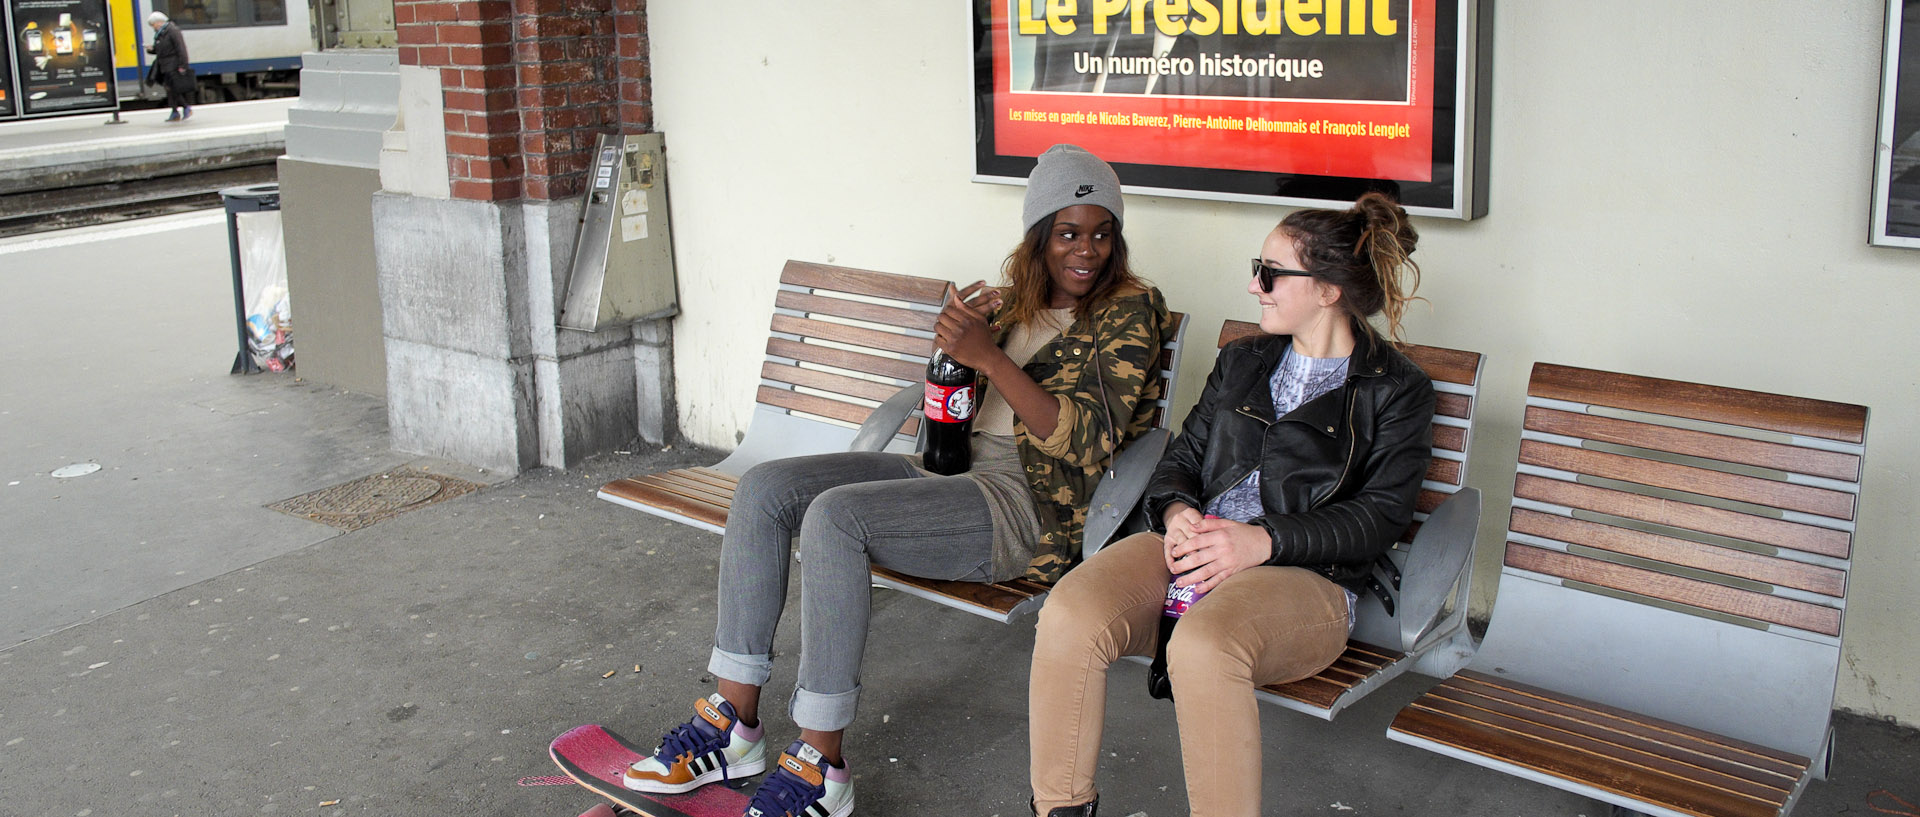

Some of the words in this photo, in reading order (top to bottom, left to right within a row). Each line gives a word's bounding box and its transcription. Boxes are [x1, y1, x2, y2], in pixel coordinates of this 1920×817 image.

[1018, 0, 1077, 35] Le
[1073, 52, 1102, 74] Un
[1108, 51, 1194, 76] numéro
[1200, 53, 1323, 81] historique
[1009, 108, 1022, 121] Les
[1024, 109, 1047, 122] mises
[1049, 113, 1059, 122] en
[1061, 111, 1085, 125] garde
[1087, 112, 1098, 124] de
[1099, 112, 1130, 126] Nicolas
[1132, 113, 1171, 130] Baverez,
[1173, 114, 1243, 130] Pierre-Antoine
[1246, 117, 1307, 134] Delhommais
[1309, 121, 1320, 134] et
[1323, 120, 1366, 137] François
[1369, 122, 1410, 139] Lenglet
